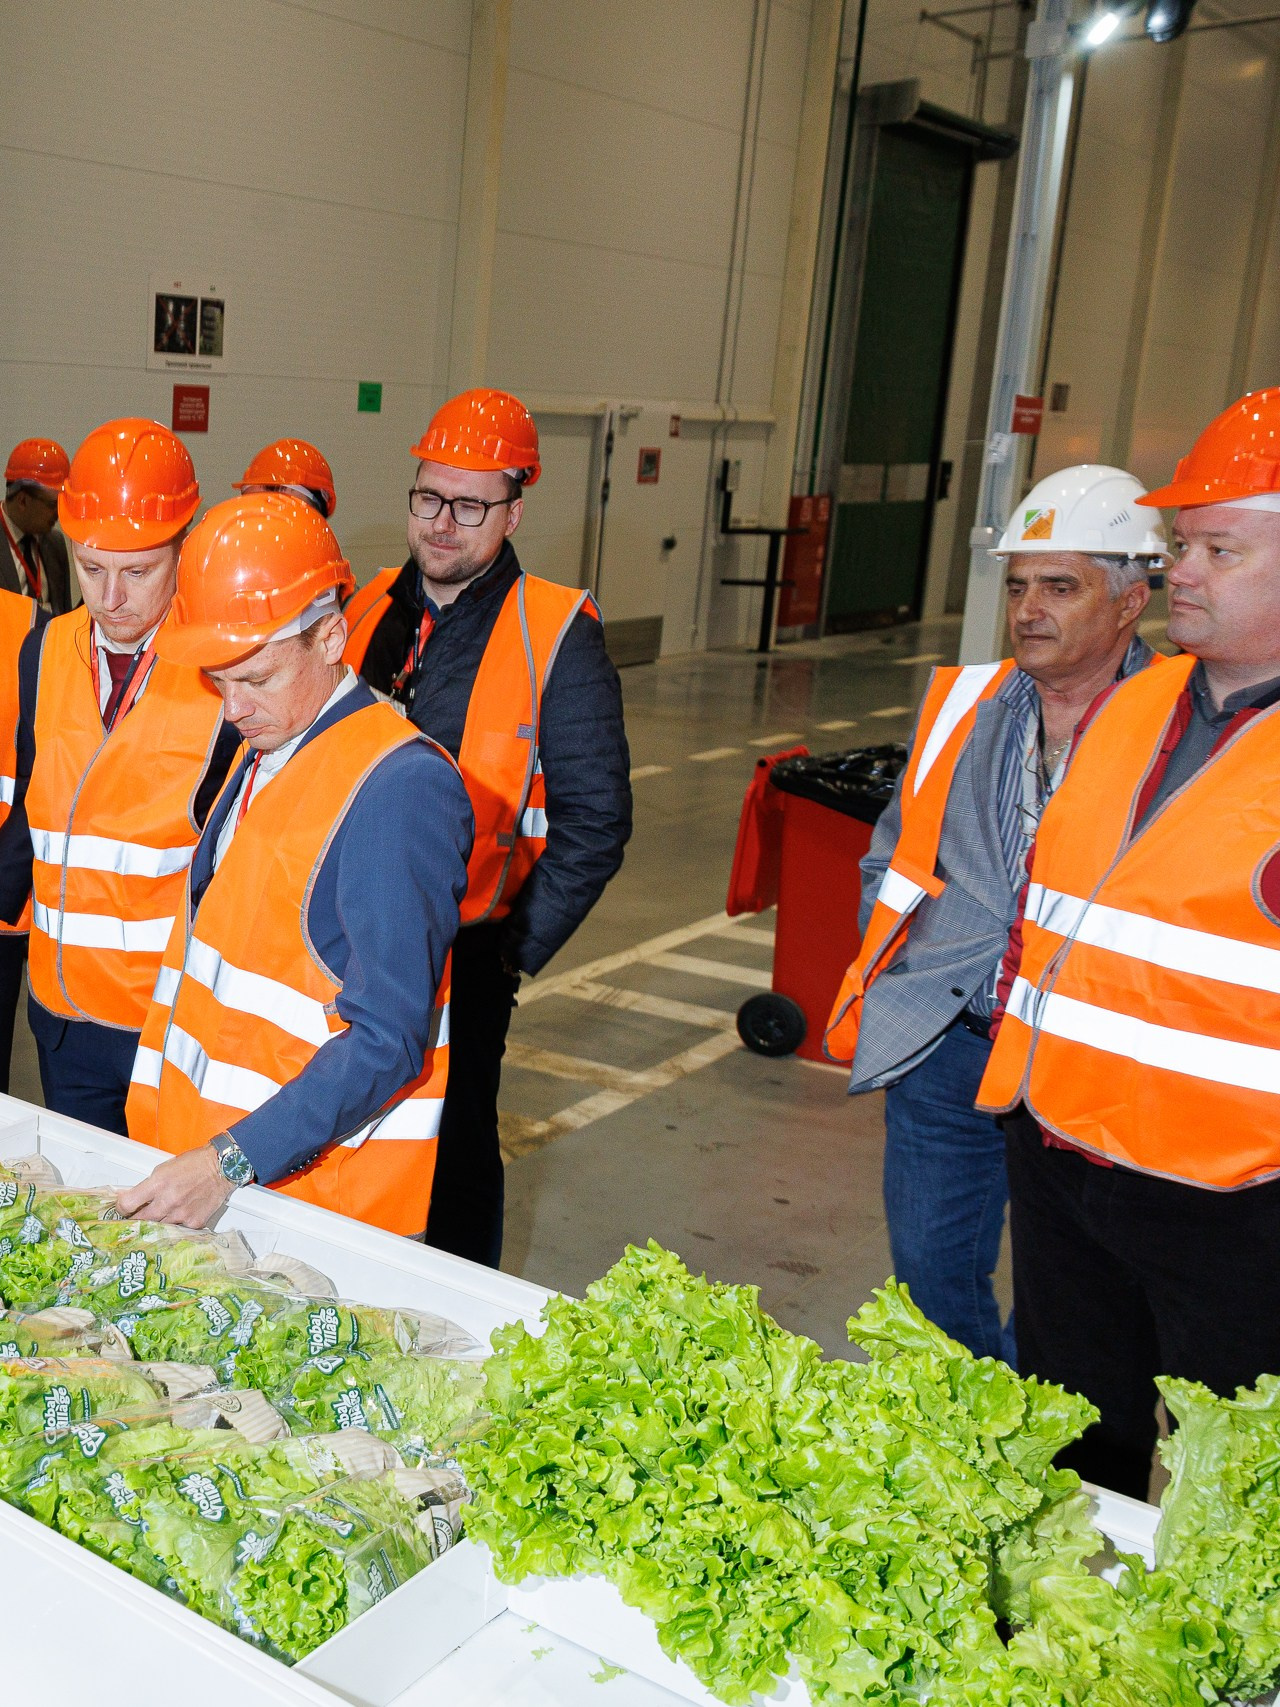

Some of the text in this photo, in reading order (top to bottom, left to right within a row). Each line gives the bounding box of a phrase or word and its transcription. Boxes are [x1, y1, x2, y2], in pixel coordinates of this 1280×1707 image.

[120, 1252, 137, 1297] Global
[131, 1251, 146, 1293] Village
[205, 1295, 233, 1328] Villag
[333, 1394, 352, 1429] obal
